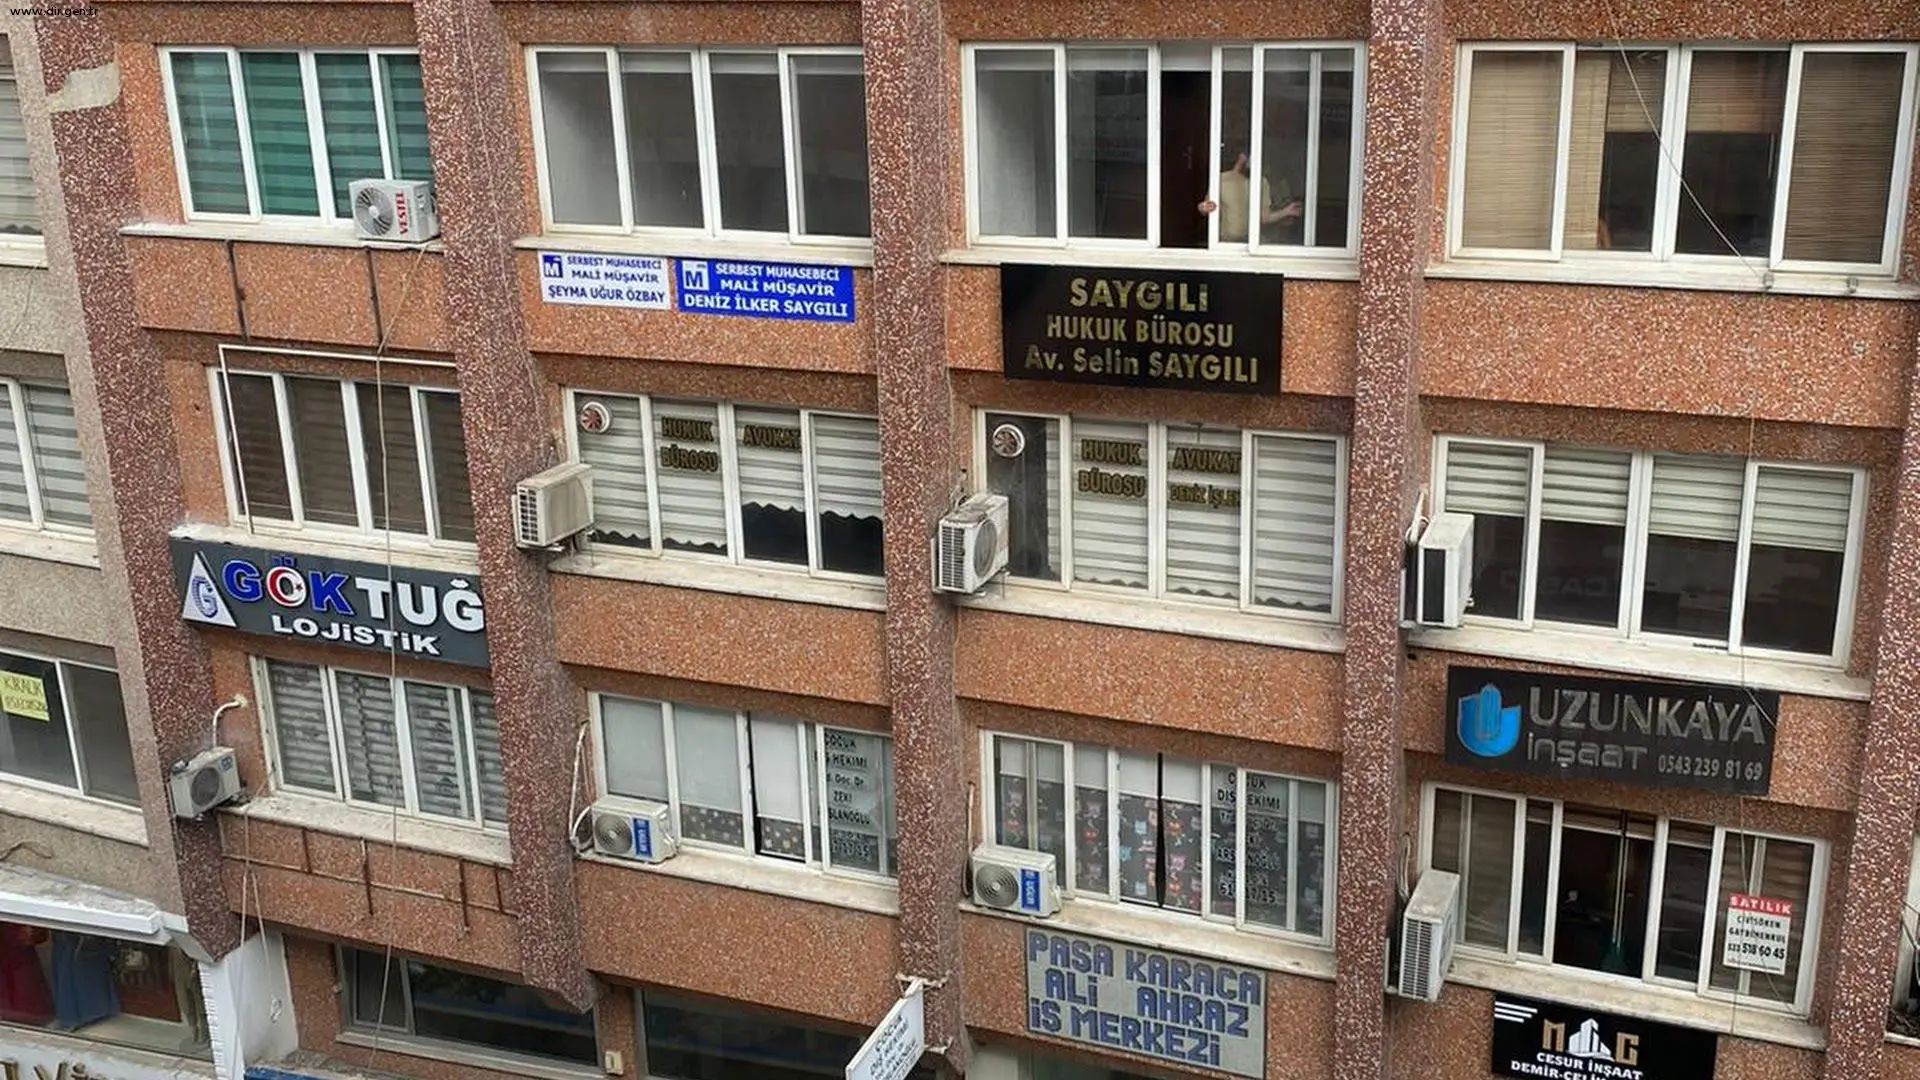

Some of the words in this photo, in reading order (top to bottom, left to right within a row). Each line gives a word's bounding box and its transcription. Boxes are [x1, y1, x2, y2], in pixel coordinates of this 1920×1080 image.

[396, 192, 408, 235] VESTEL
[567, 256, 603, 266] SERBEST
[715, 263, 762, 276] SERBEST
[766, 266, 840, 281] MUHASEBECİ
[571, 269, 601, 280] MALİ
[605, 271, 660, 284] MÜŞAVİR
[720, 278, 759, 292] MALİ
[763, 279, 835, 297] MÜŞAVİR
[548, 285, 588, 298] ŞEYMA
[590, 285, 623, 300] UĞUR
[626, 286, 666, 302] ÖZBAY
[684, 293, 731, 309] DENİZ
[735, 293, 780, 312] İLKER
[783, 300, 848, 317] SAYGILI
[1047, 315, 1127, 342] HUKUK
[1136, 314, 1233, 348] BÜROSU
[1024, 344, 1064, 371] Av.
[1073, 347, 1139, 376] Selin
[1148, 351, 1259, 383] SAYGILI
[661, 416, 714, 442] HUKUK
[742, 425, 800, 449] AVUKAT
[660, 443, 718, 472] BÜROSU
[1081, 439, 1142, 466] HUKUK
[1173, 447, 1241, 475] AVUKAT
[1078, 467, 1146, 498] BÜROSU
[222, 553, 485, 633] GÖKTUĞ
[1529, 685, 1767, 745] UZUNKAYA
[1658, 754, 1691, 776] 0543
[1694, 757, 1719, 777] 239
[1725, 759, 1741, 780] 81
[1744, 760, 1762, 781] 69
[1730, 896, 1791, 914] SATILIK
[1759, 945, 1771, 957] 60
[1773, 947, 1785, 959] 45
[1125, 949, 1262, 1006] KARACA
[1136, 986, 1250, 1038] AHRAZ
[1536, 1052, 1583, 1070] CESUR
[1588, 1059, 1643, 1080] İNŞAAT
